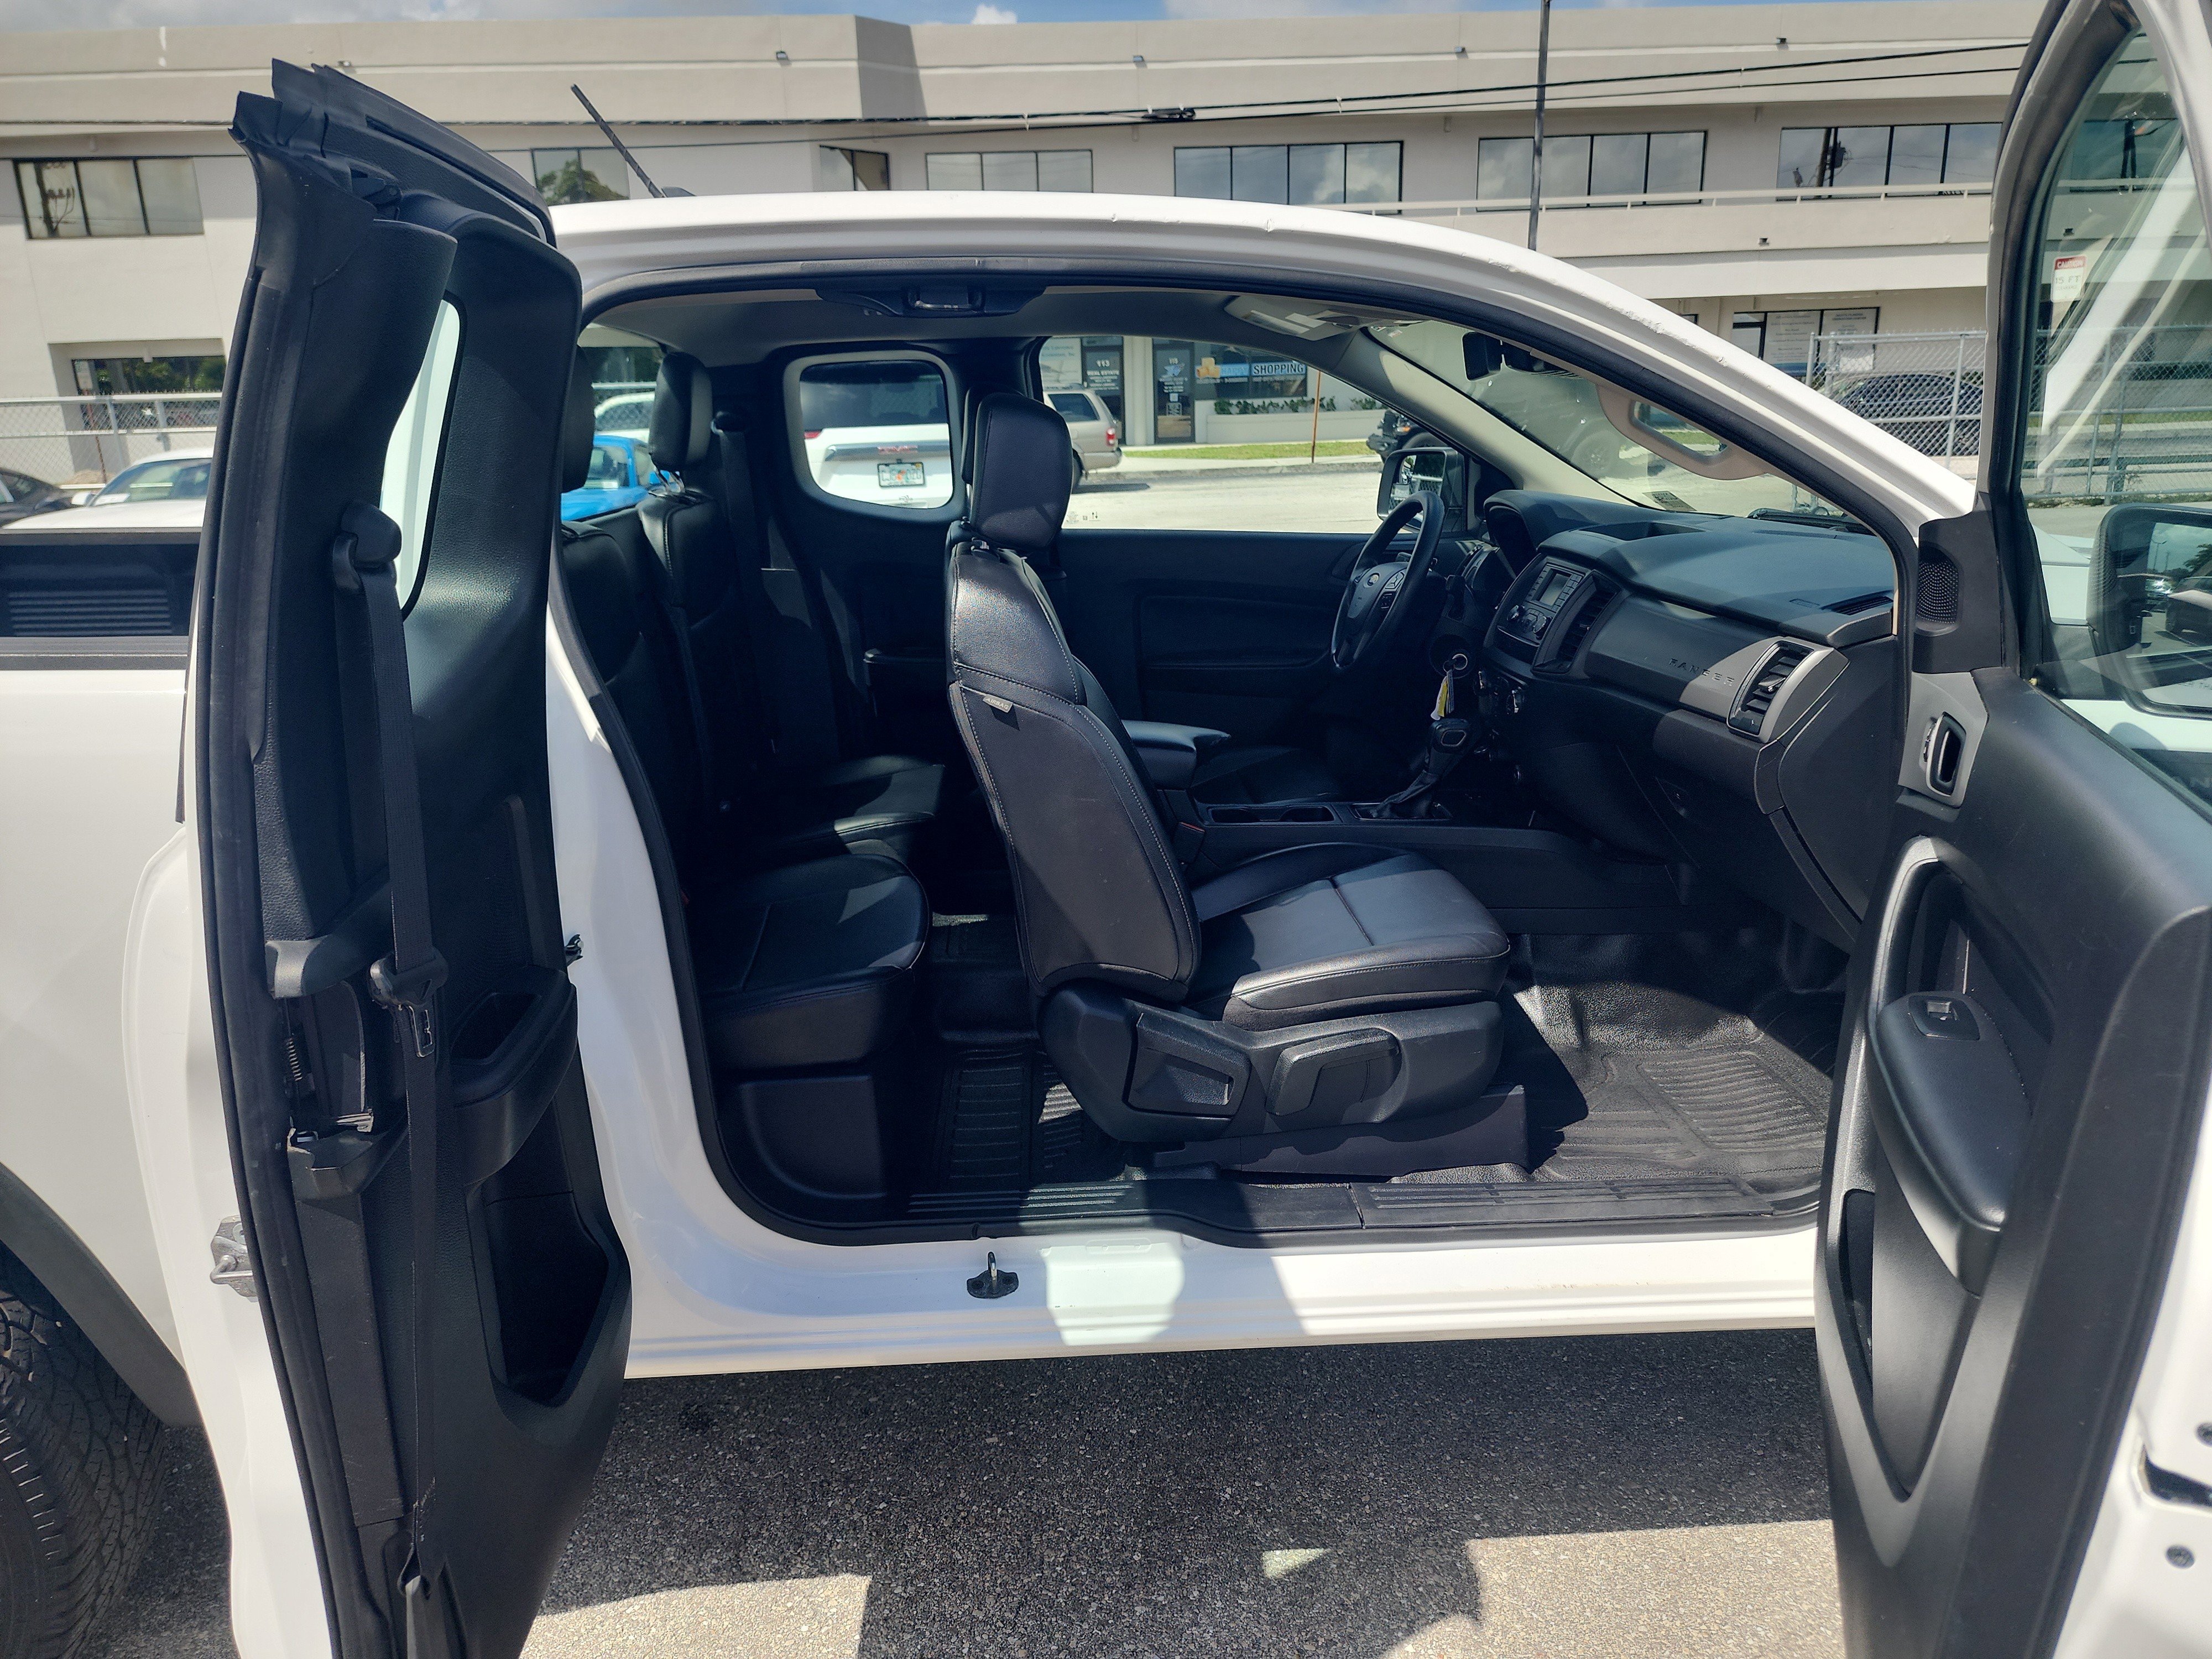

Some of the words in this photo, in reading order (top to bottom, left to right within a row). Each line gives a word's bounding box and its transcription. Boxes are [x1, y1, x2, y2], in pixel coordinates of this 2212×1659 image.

[2057, 259, 2083, 268] CAUTION
[1254, 363, 1303, 375] SHOPPING
[1669, 658, 1735, 686] RANGER
[985, 698, 1009, 710] AIRBAG
